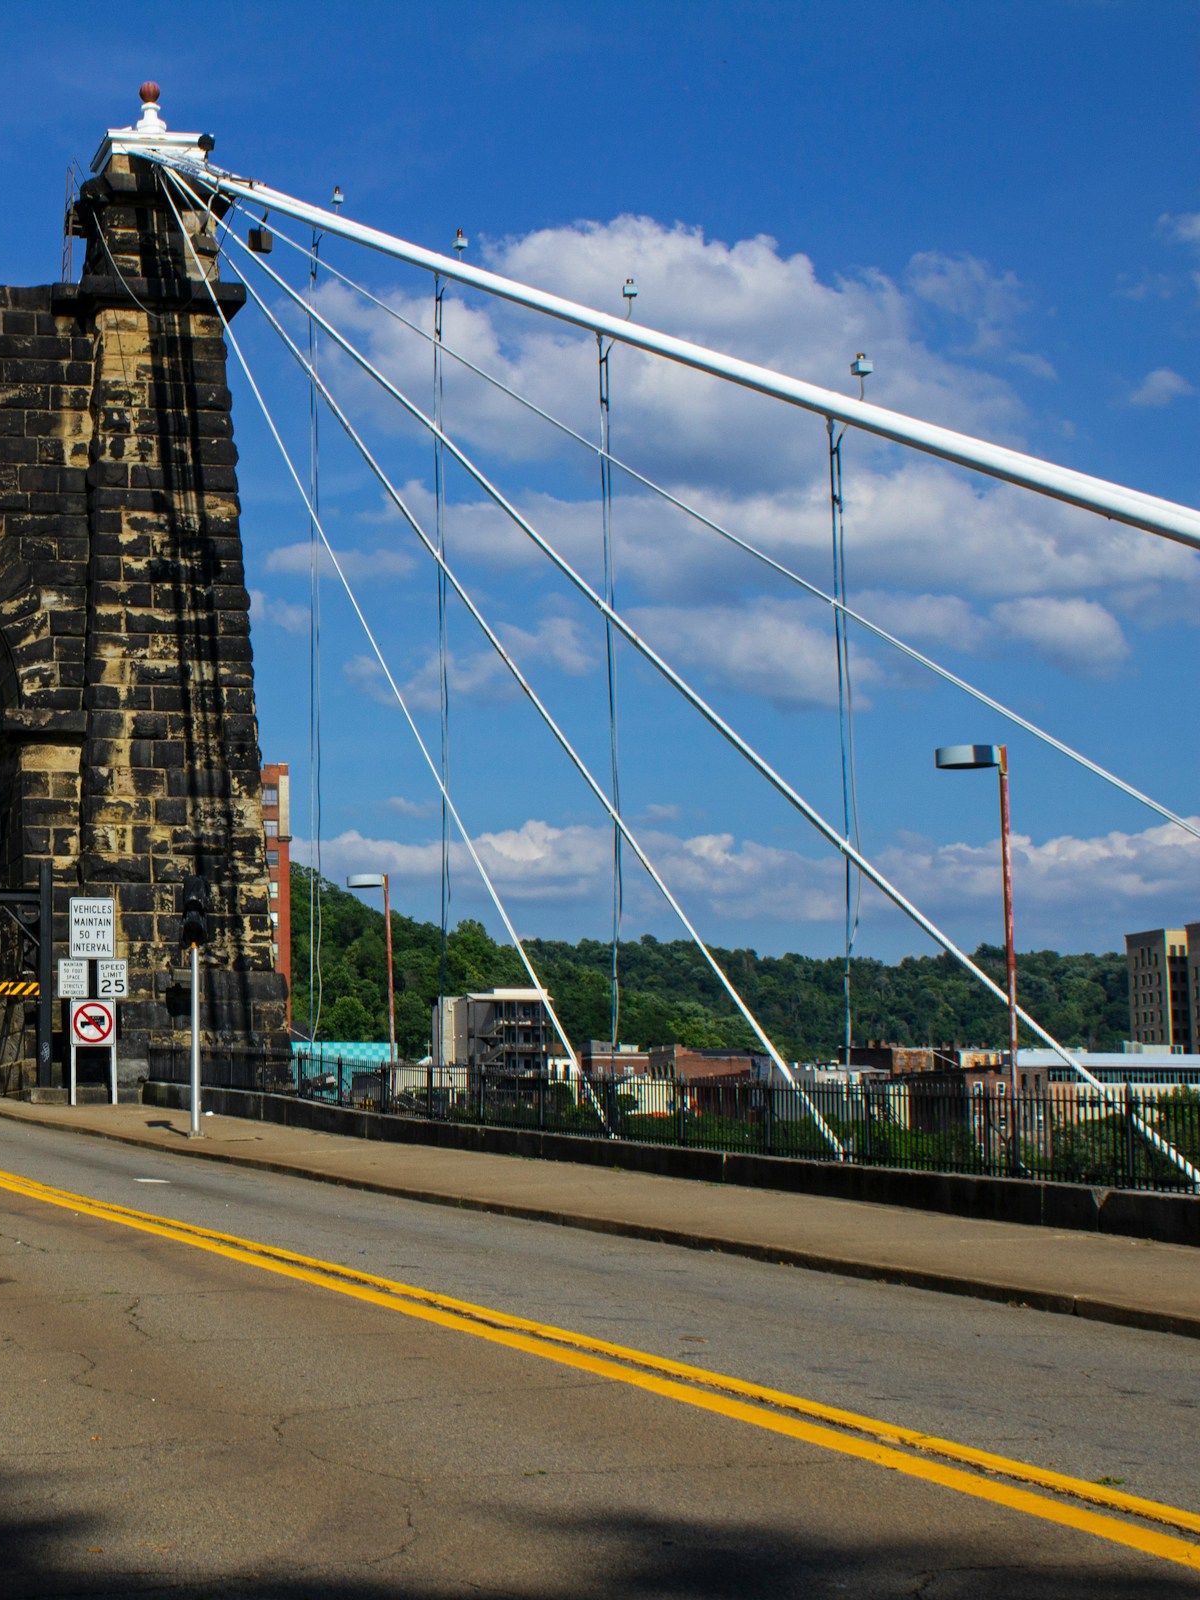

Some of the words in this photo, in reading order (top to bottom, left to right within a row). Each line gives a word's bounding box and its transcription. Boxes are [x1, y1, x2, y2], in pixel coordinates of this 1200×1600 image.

[73, 905, 111, 914] VEHICLES
[74, 918, 111, 926] MAINTAIN
[79, 931, 90, 939] 50
[96, 931, 106, 939] FT
[73, 943, 111, 952] INTERVAL
[101, 979, 125, 993] 25
